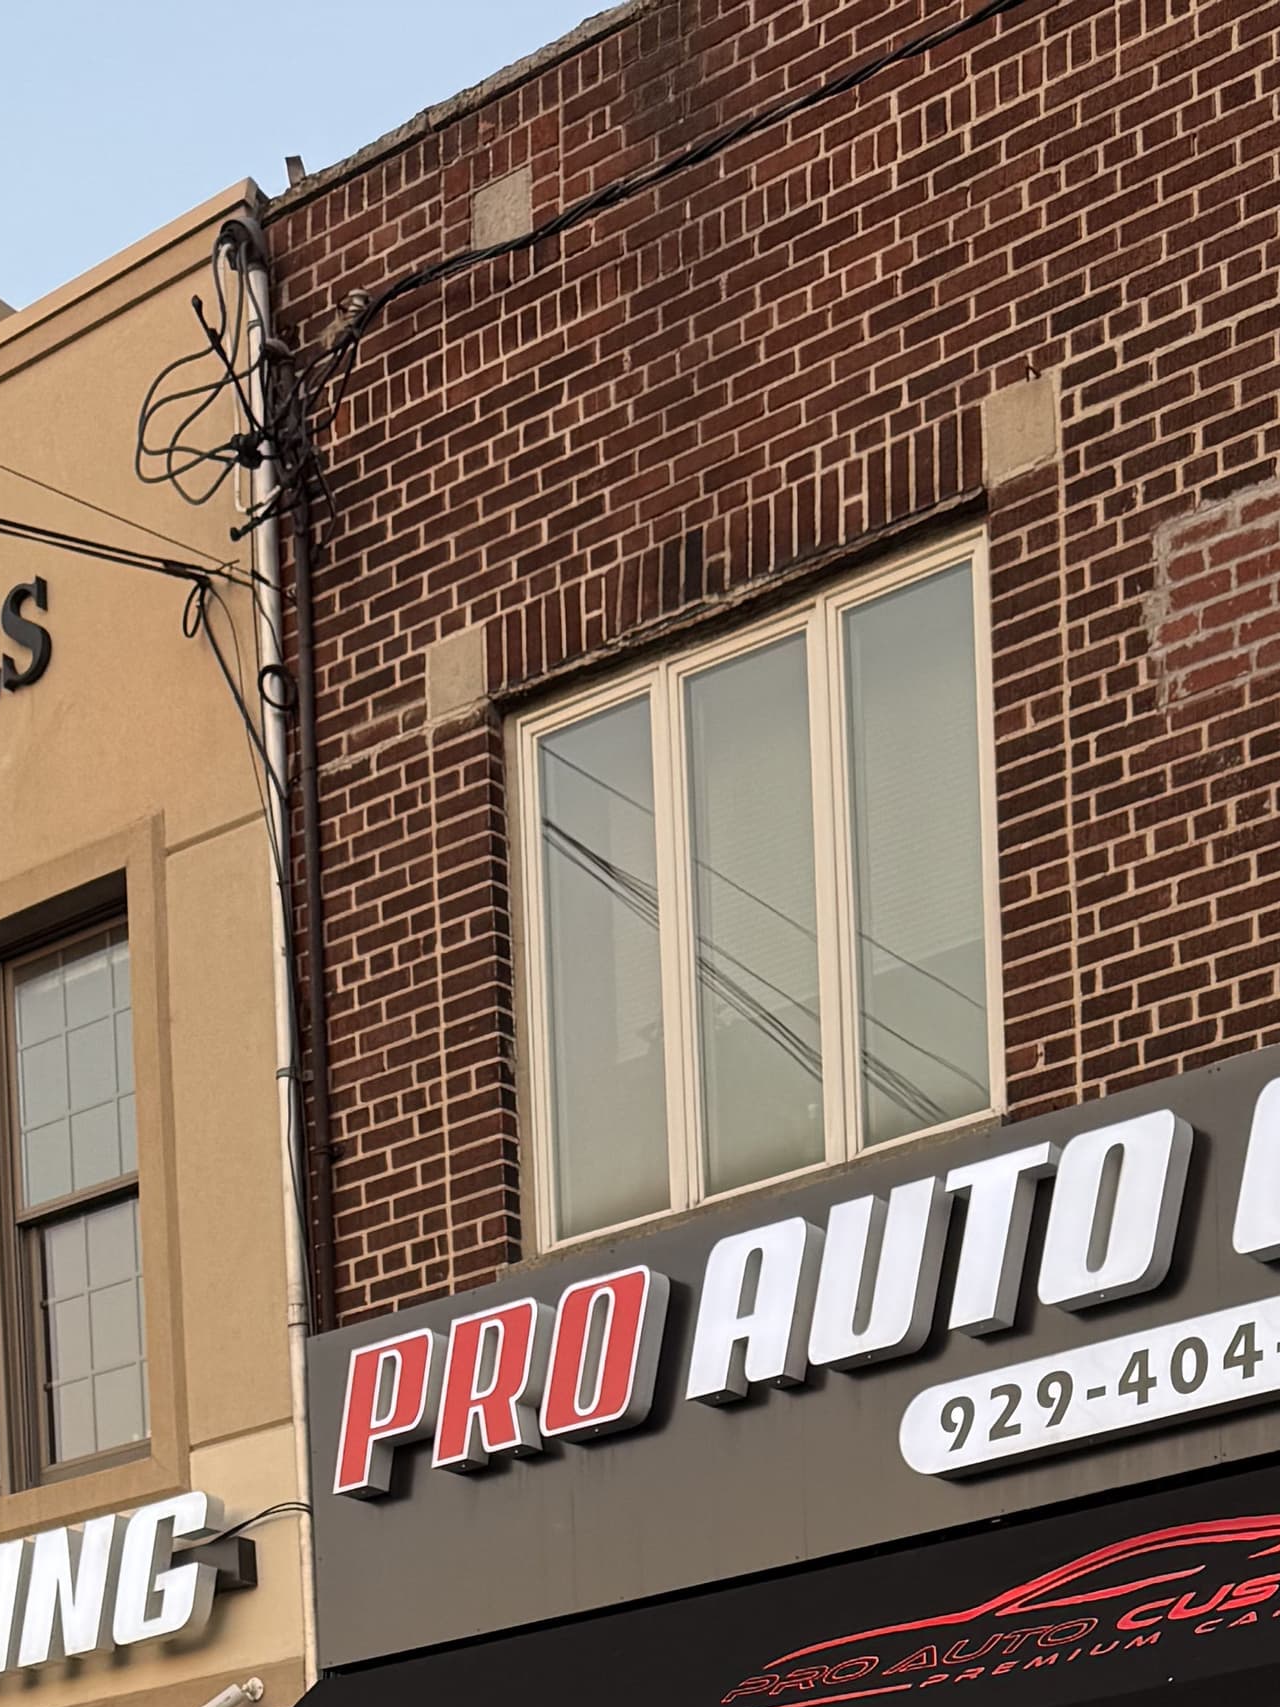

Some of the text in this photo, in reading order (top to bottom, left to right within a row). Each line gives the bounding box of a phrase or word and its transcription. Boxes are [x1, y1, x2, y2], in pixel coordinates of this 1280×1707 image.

[333, 1265, 665, 1497] PRO
[686, 1108, 1192, 1402] AUTO
[721, 1653, 878, 1703] PRO
[882, 1617, 1099, 1677] AUTO
[919, 1632, 1162, 1688] PREMIUM
